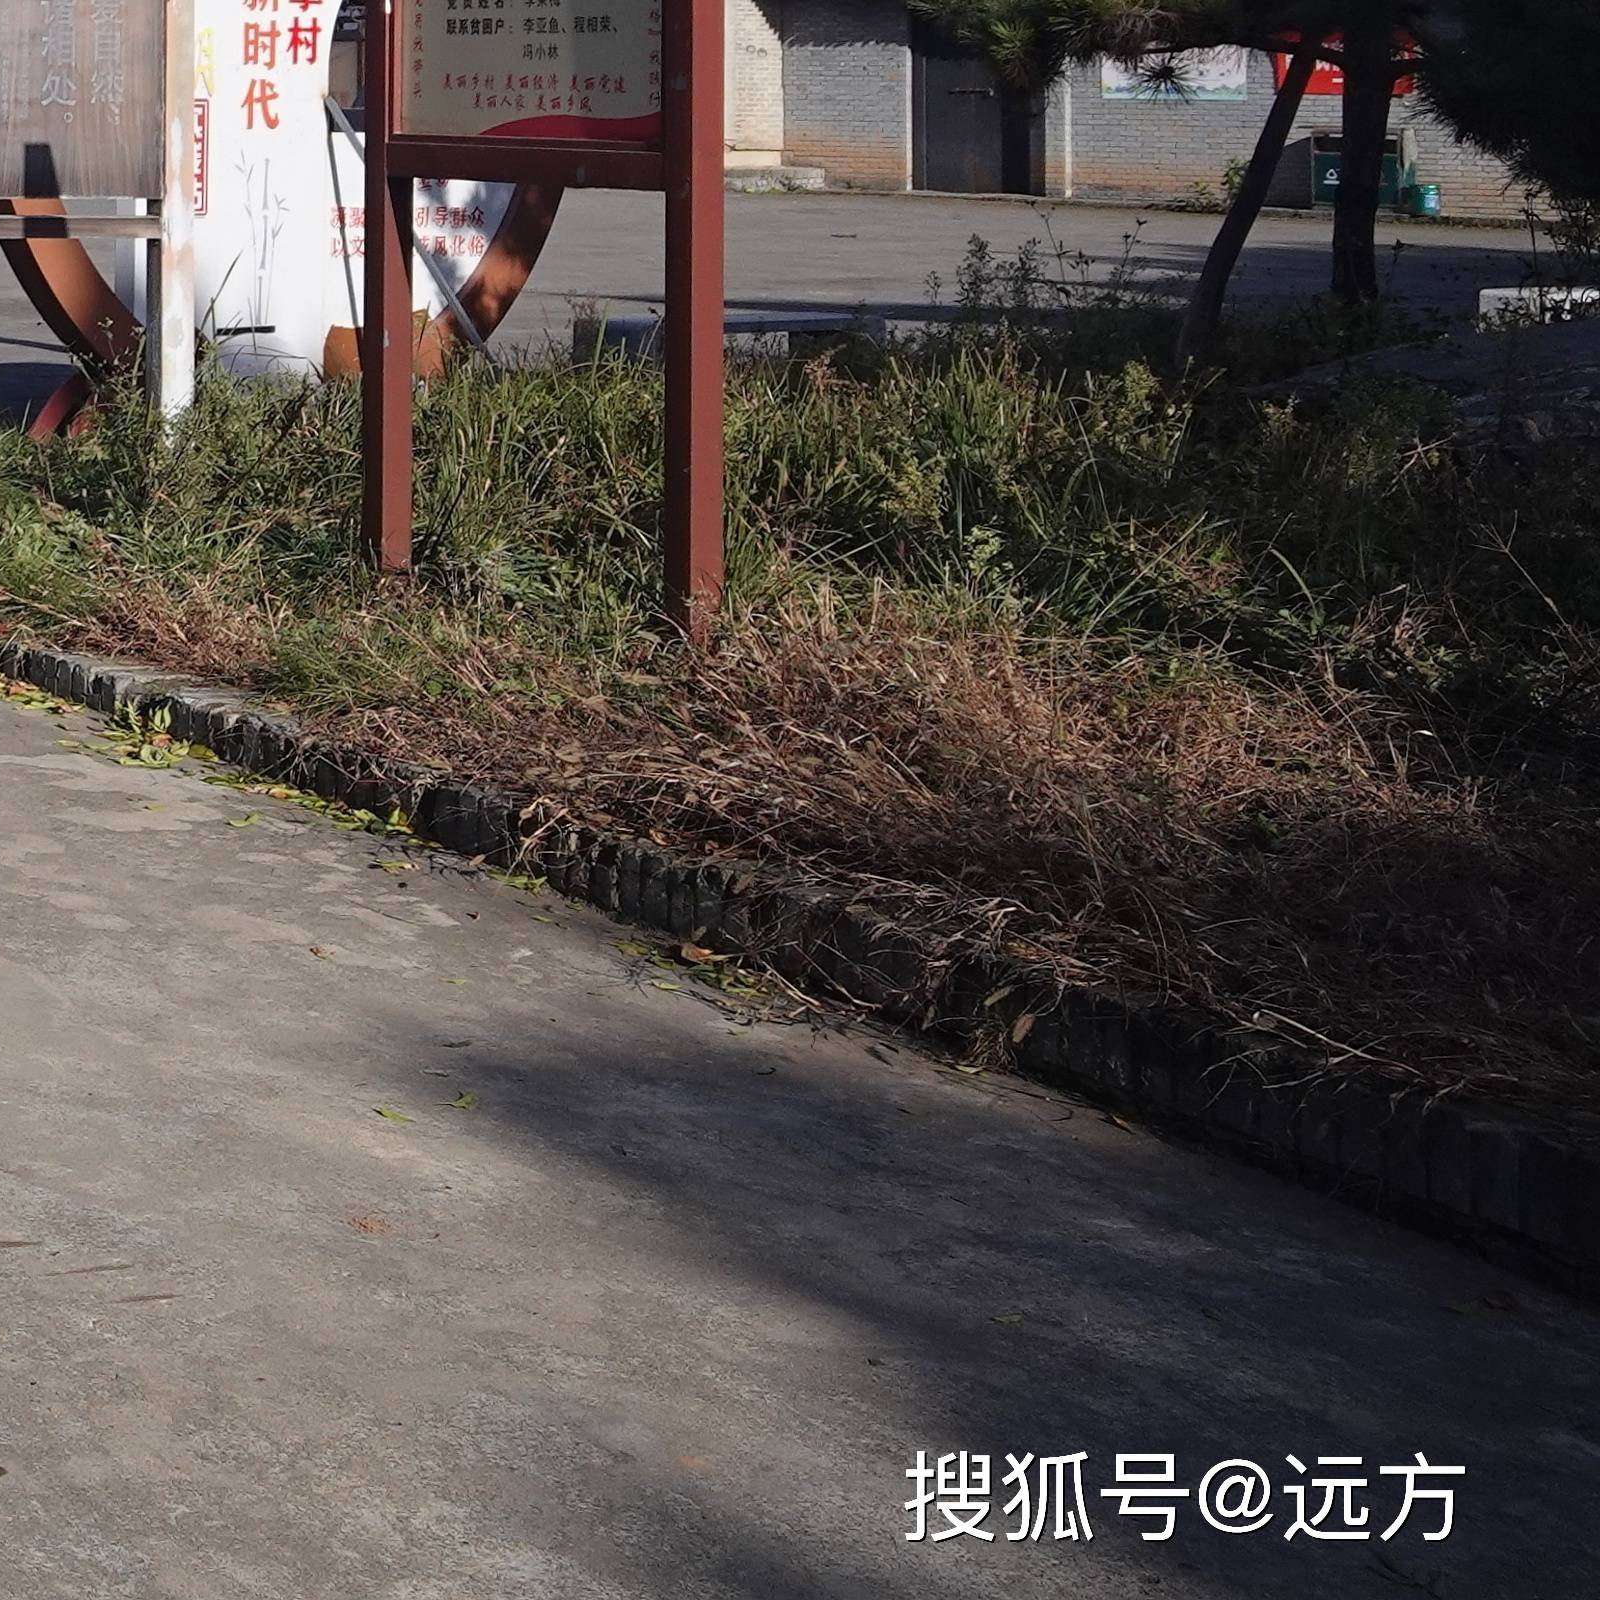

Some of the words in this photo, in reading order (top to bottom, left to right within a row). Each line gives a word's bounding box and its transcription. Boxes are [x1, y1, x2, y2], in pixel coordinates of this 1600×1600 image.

[522, 43, 560, 61] 冯小林
[416, 206, 486, 230] 引导群众
